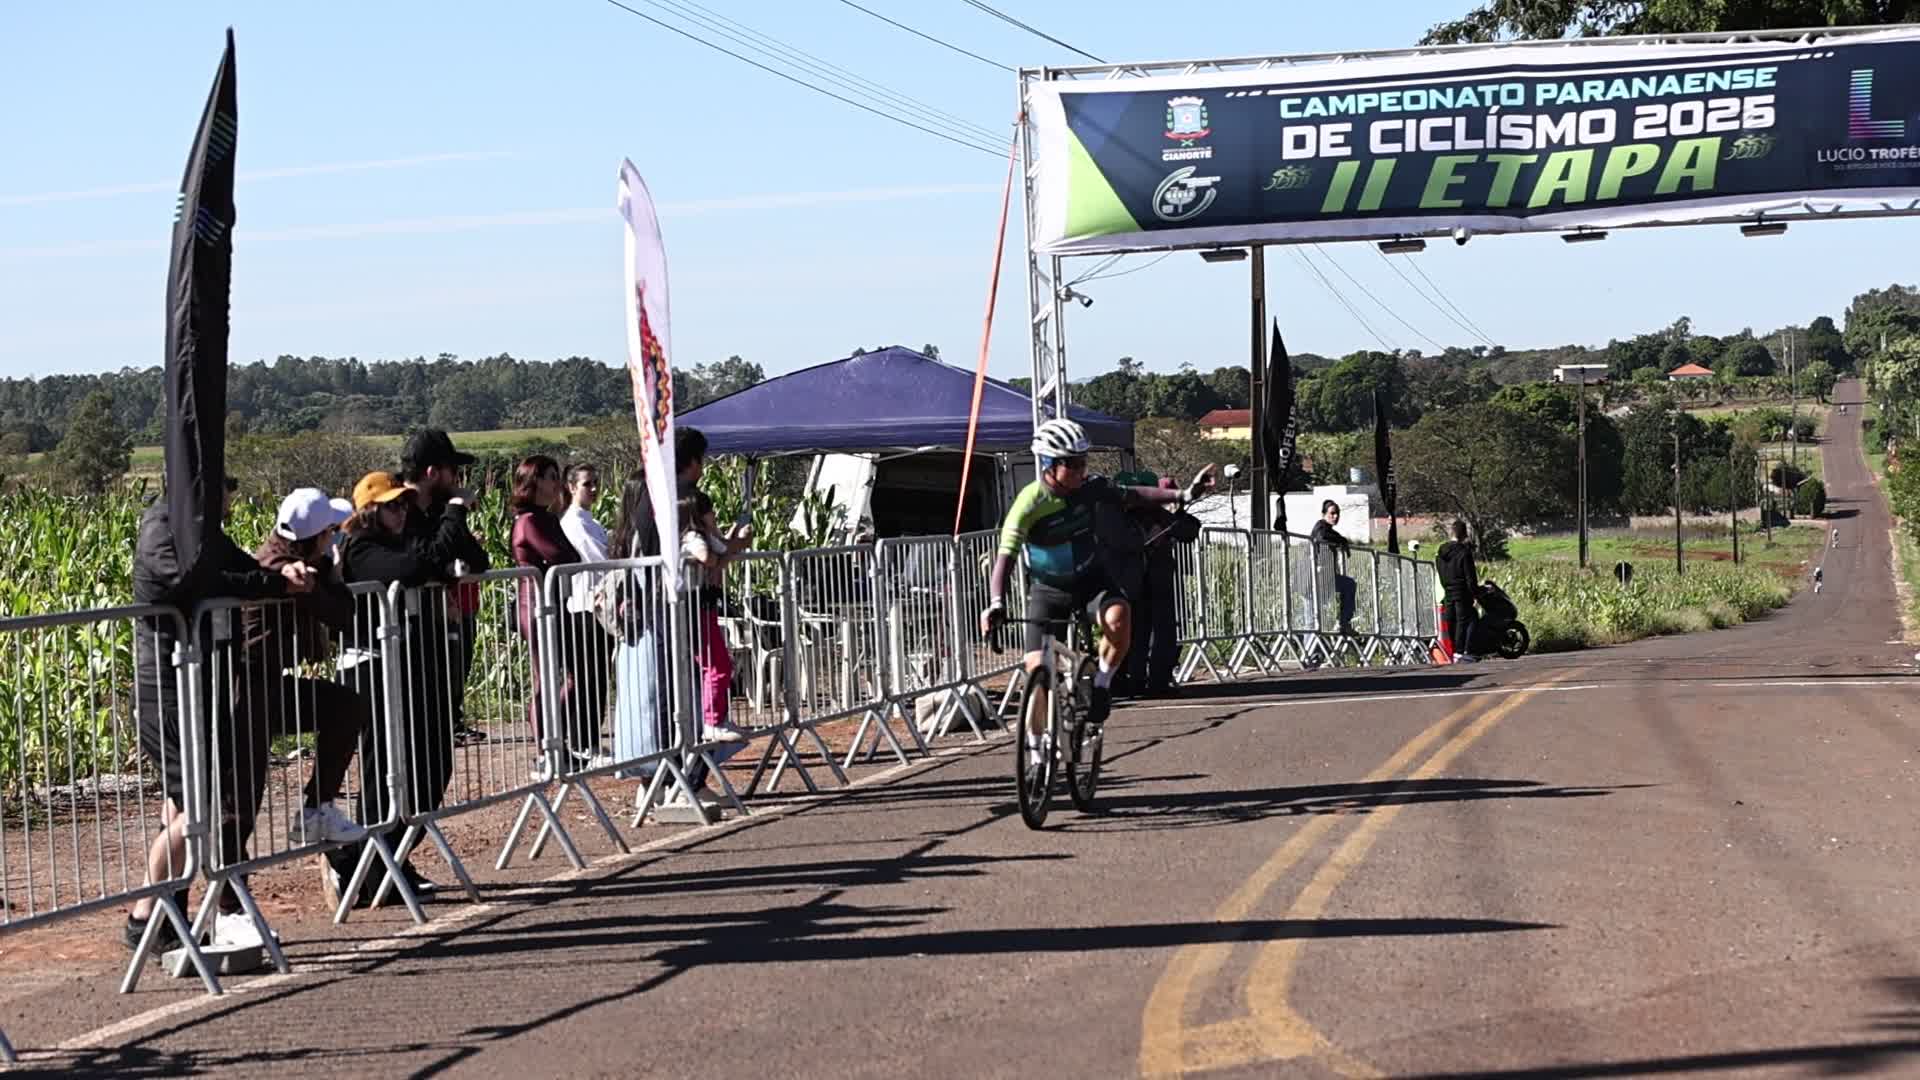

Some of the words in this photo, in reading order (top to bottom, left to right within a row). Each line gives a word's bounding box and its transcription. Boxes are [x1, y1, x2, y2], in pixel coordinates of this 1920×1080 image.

[1280, 83, 1525, 119] CAMPEONATO
[1536, 67, 1778, 106] PARANAENSE
[1282, 122, 1353, 160] DE
[1369, 105, 1617, 154] CICLÍSMO
[1633, 94, 1776, 139] 2025
[1162, 150, 1213, 161] CIANORTE
[1320, 158, 1398, 213] II
[1418, 136, 1722, 209] ETAPA
[1817, 147, 1866, 162] LUCIO
[1869, 145, 1920, 160] TROFÉ
